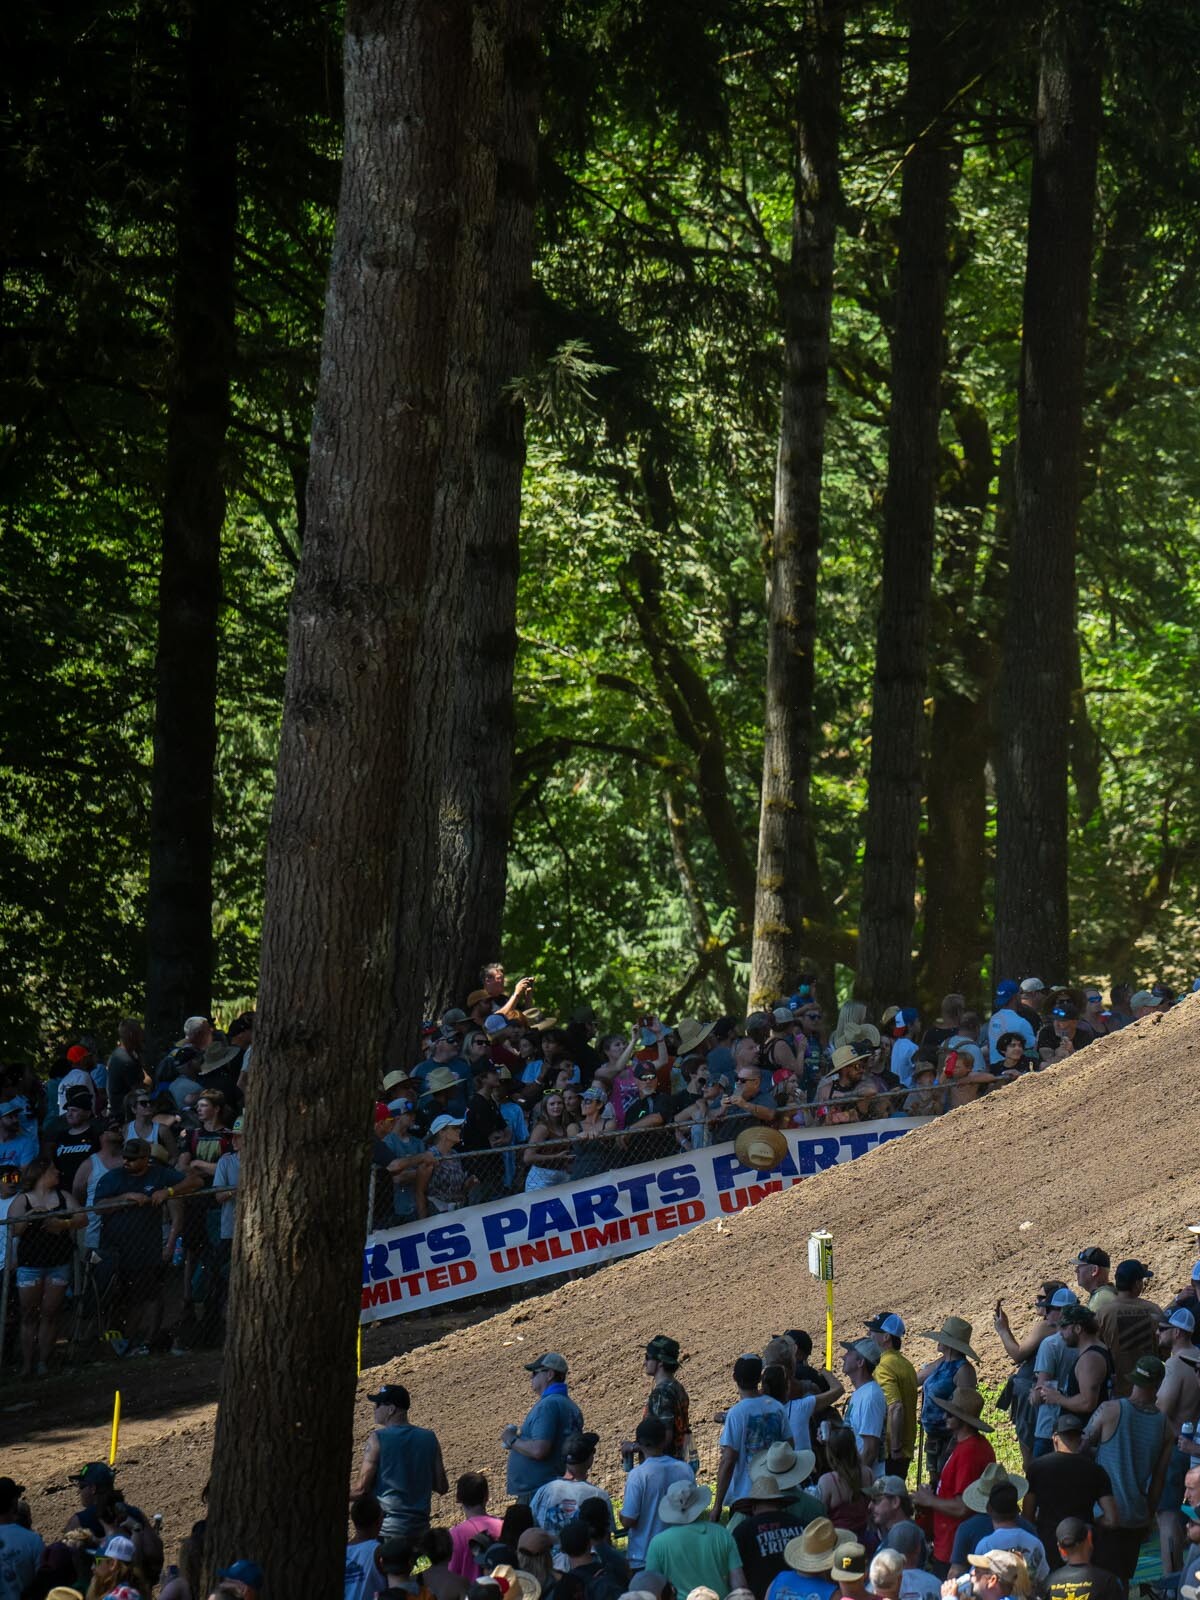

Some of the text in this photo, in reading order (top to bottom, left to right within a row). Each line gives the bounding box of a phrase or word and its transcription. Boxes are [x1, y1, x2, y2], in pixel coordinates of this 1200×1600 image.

[361, 1199, 705, 1310] MITED UNLIMITED
[363, 1222, 472, 1284] RTS
[482, 1163, 701, 1251] PARTS
